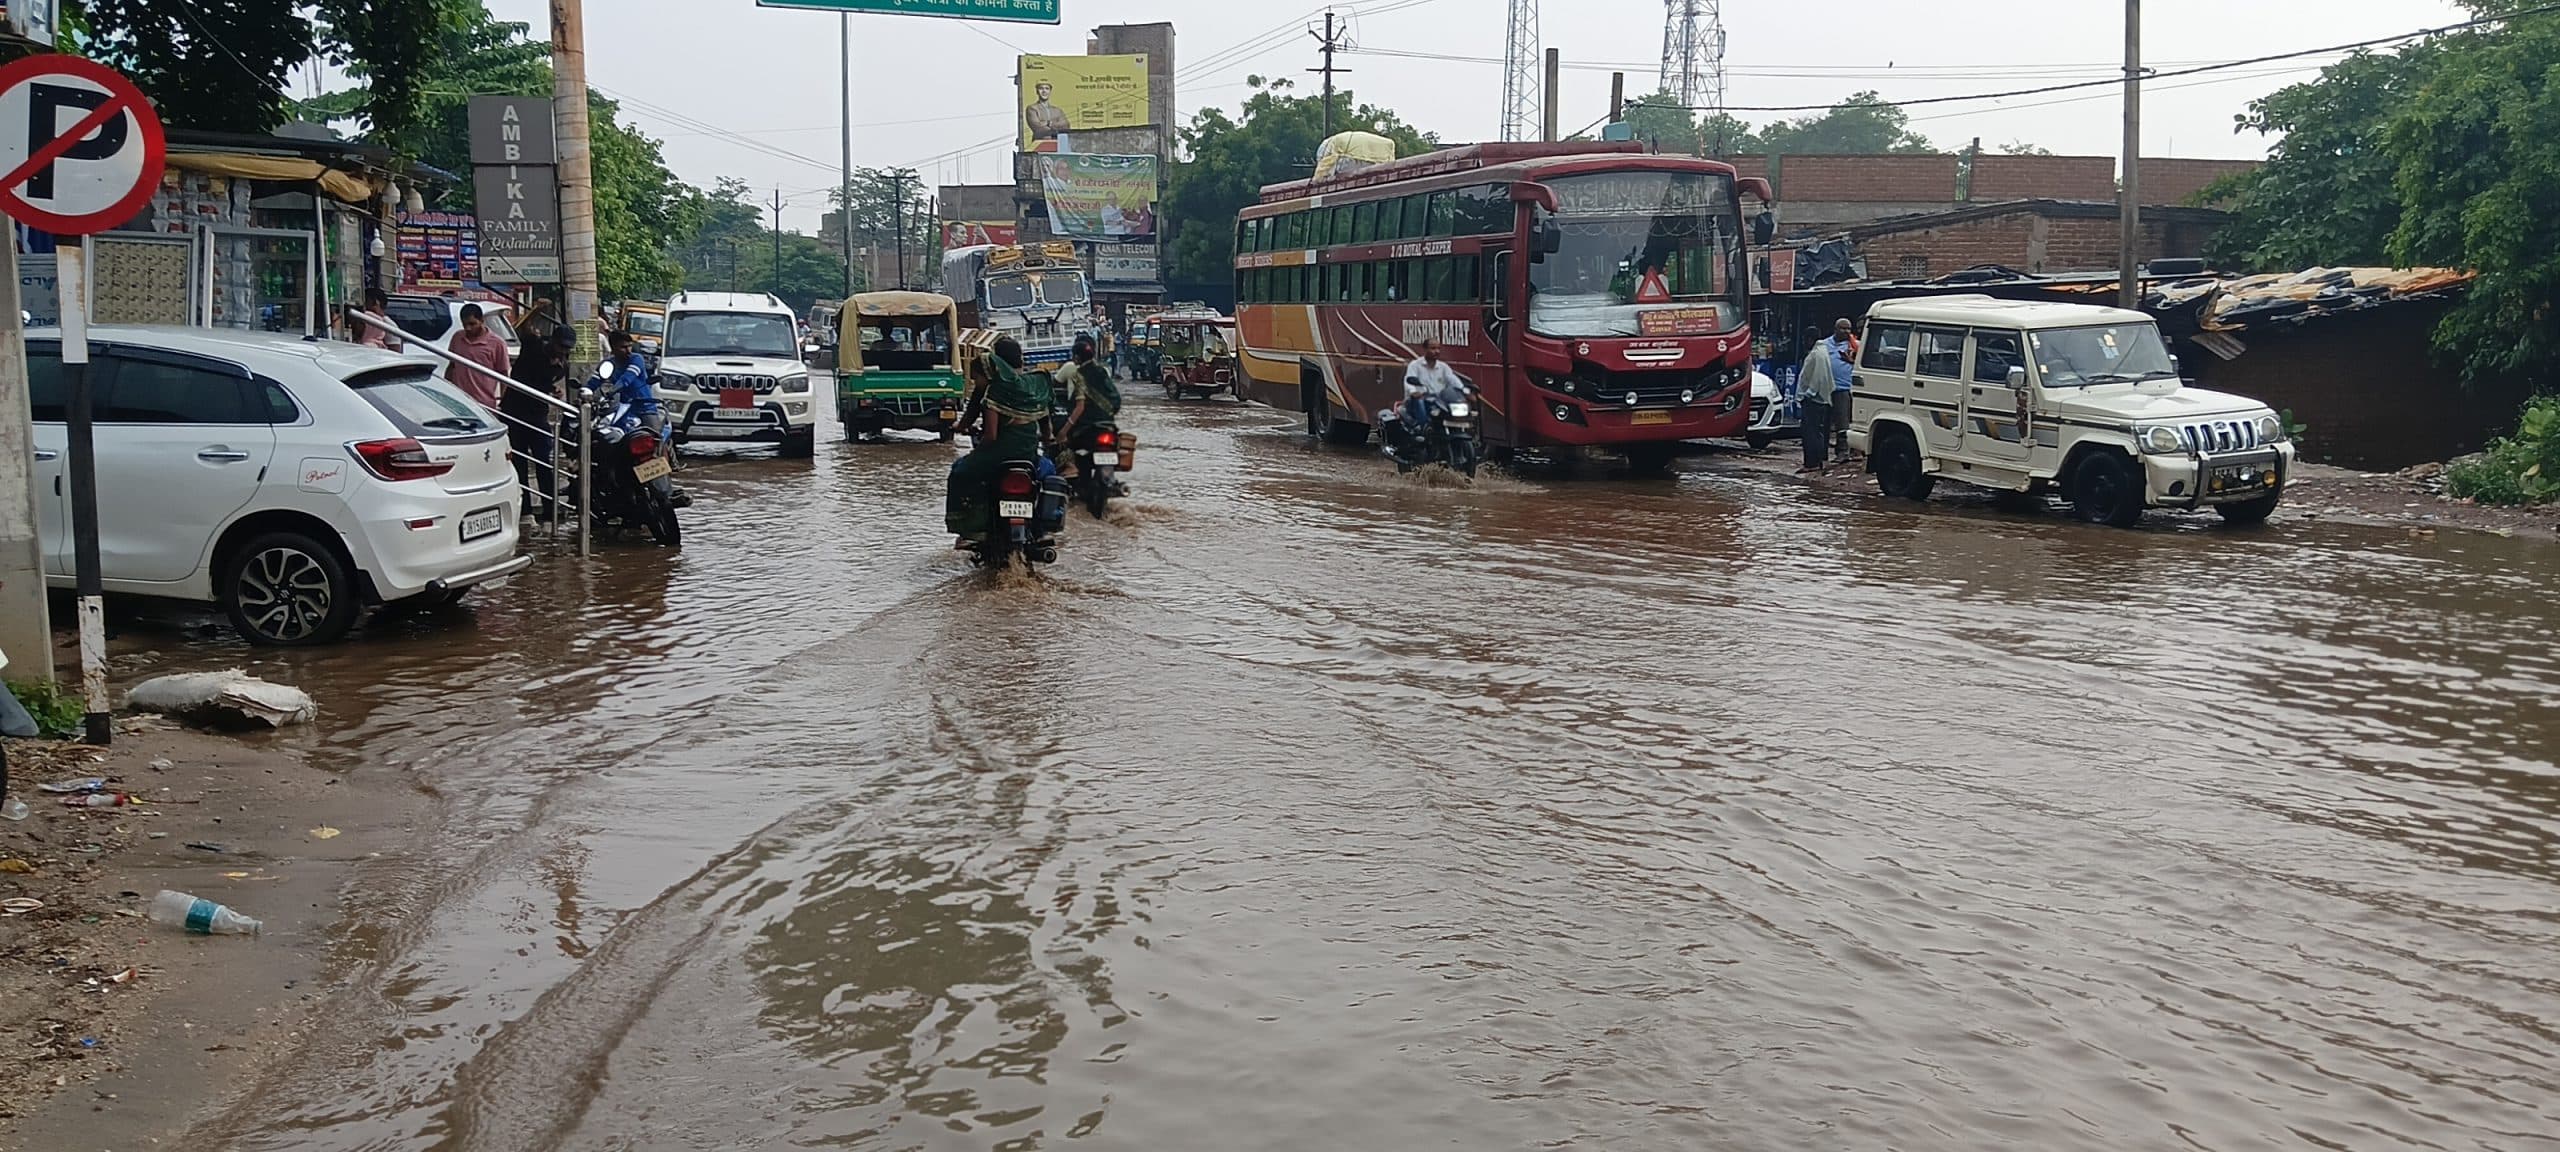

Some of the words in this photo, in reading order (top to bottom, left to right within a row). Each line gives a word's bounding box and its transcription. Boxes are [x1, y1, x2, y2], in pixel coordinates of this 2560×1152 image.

[1013, 0, 1040, 10] करता
[1045, 0, 1053, 12] है
[27, 82, 128, 200] P
[502, 105, 525, 219] AMBIKA
[483, 221, 551, 232] FAMILY
[1122, 244, 1155, 254] TELECOM
[1402, 319, 1440, 344] KRISHNA
[1442, 319, 1470, 346] RAJAT
